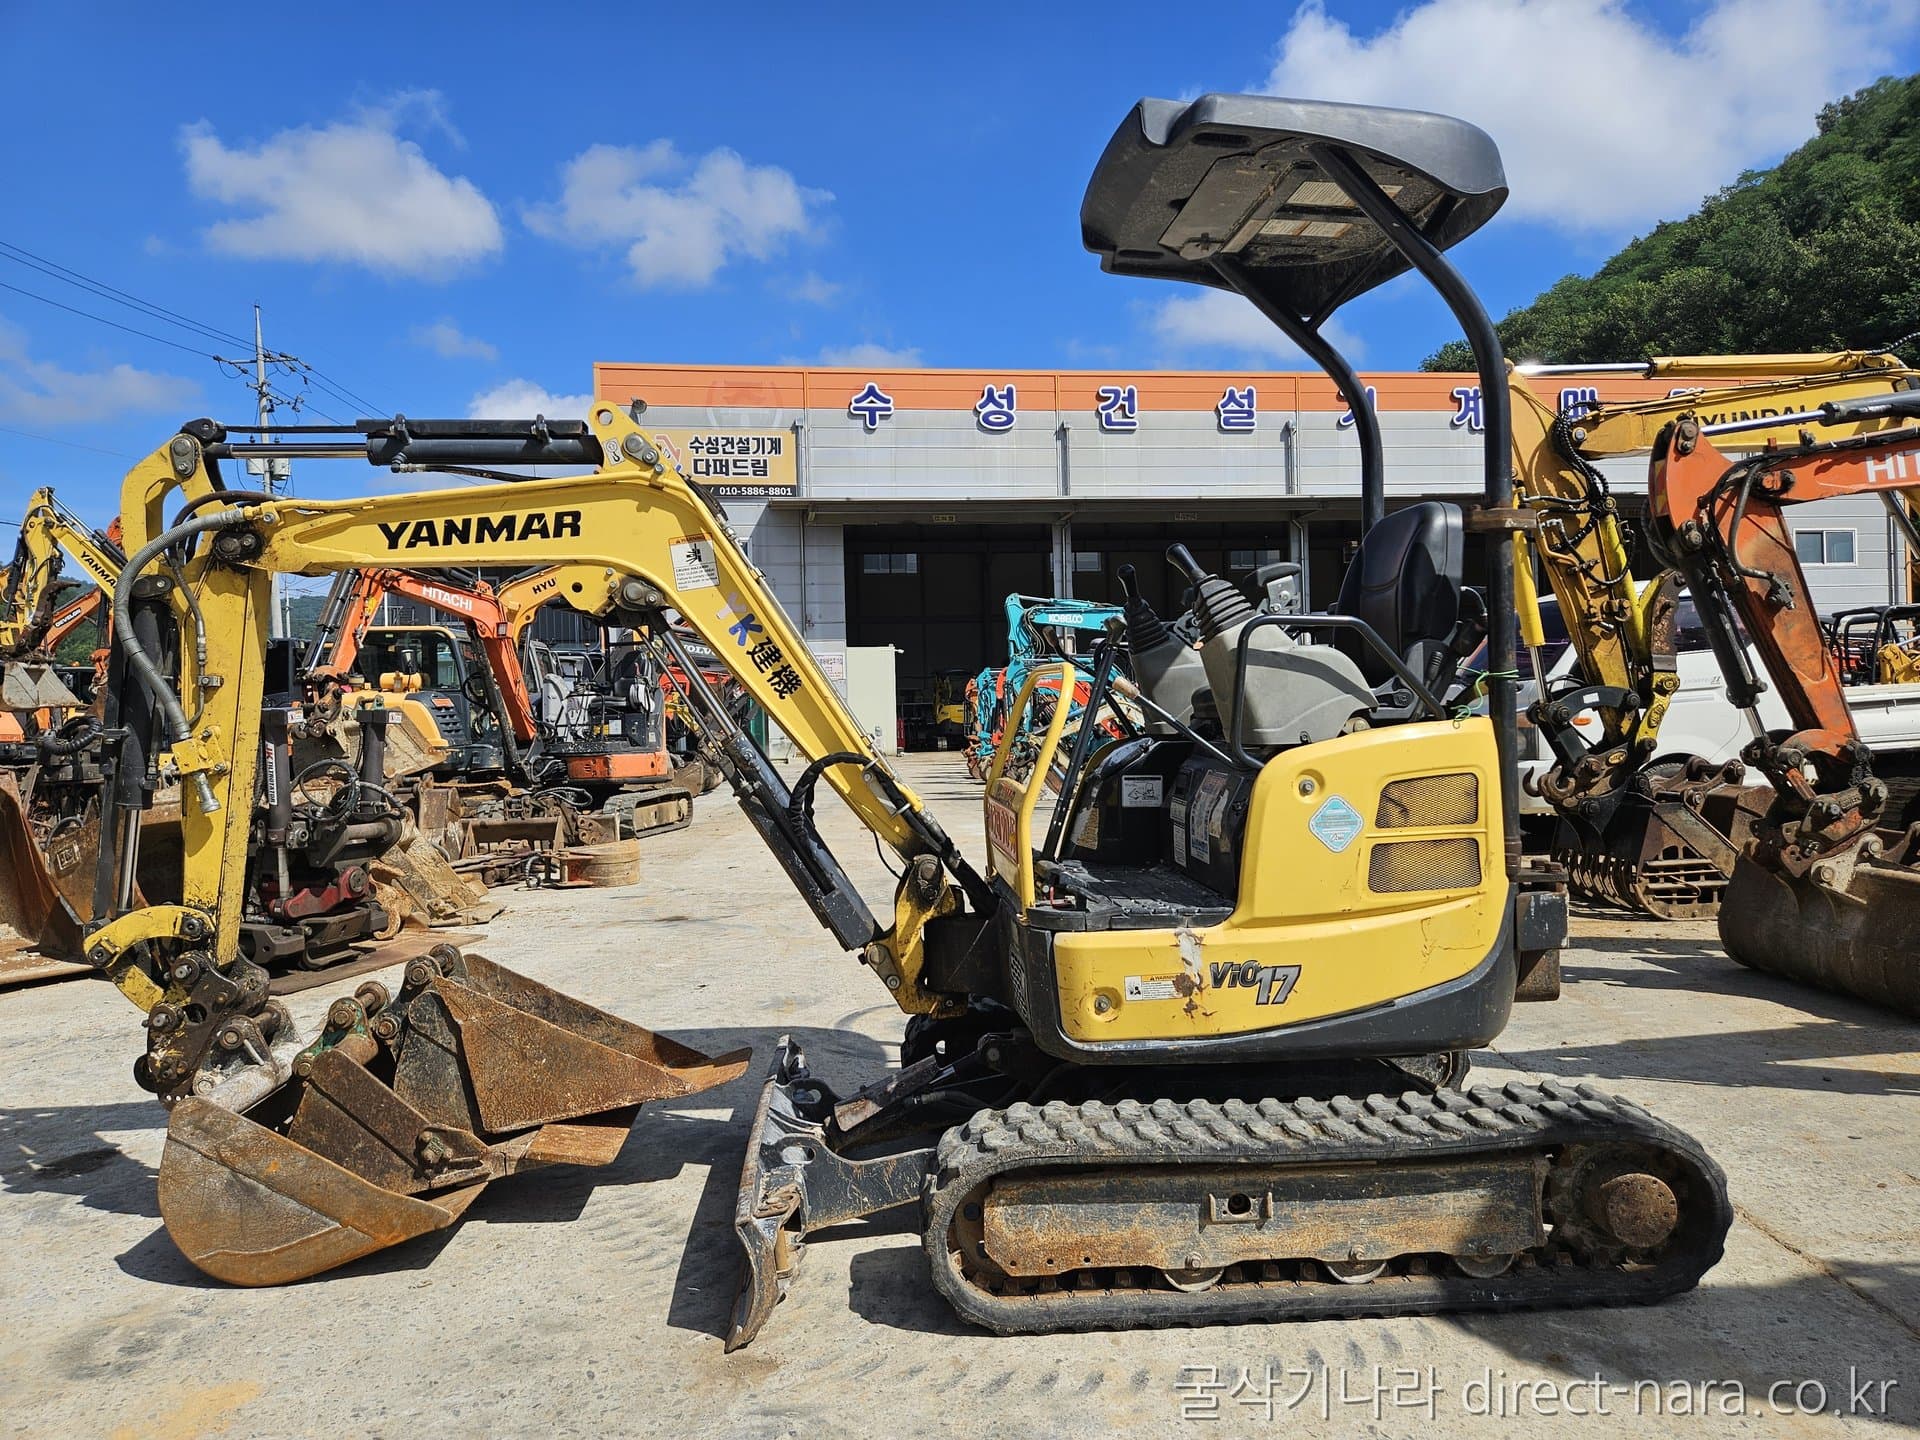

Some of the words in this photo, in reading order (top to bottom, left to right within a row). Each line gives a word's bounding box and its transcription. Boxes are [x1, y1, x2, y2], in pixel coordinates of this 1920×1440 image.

[689, 436, 782, 455] 수성건설기계
[692, 458, 768, 477] 다퍼드림
[719, 486, 792, 496] 010-5886-8801
[378, 510, 581, 550] YANMAR
[532, 577, 557, 594] HYU
[422, 584, 473, 611] HITACHI
[1048, 614, 1084, 624] KOBELCO
[684, 645, 716, 656] OLV
